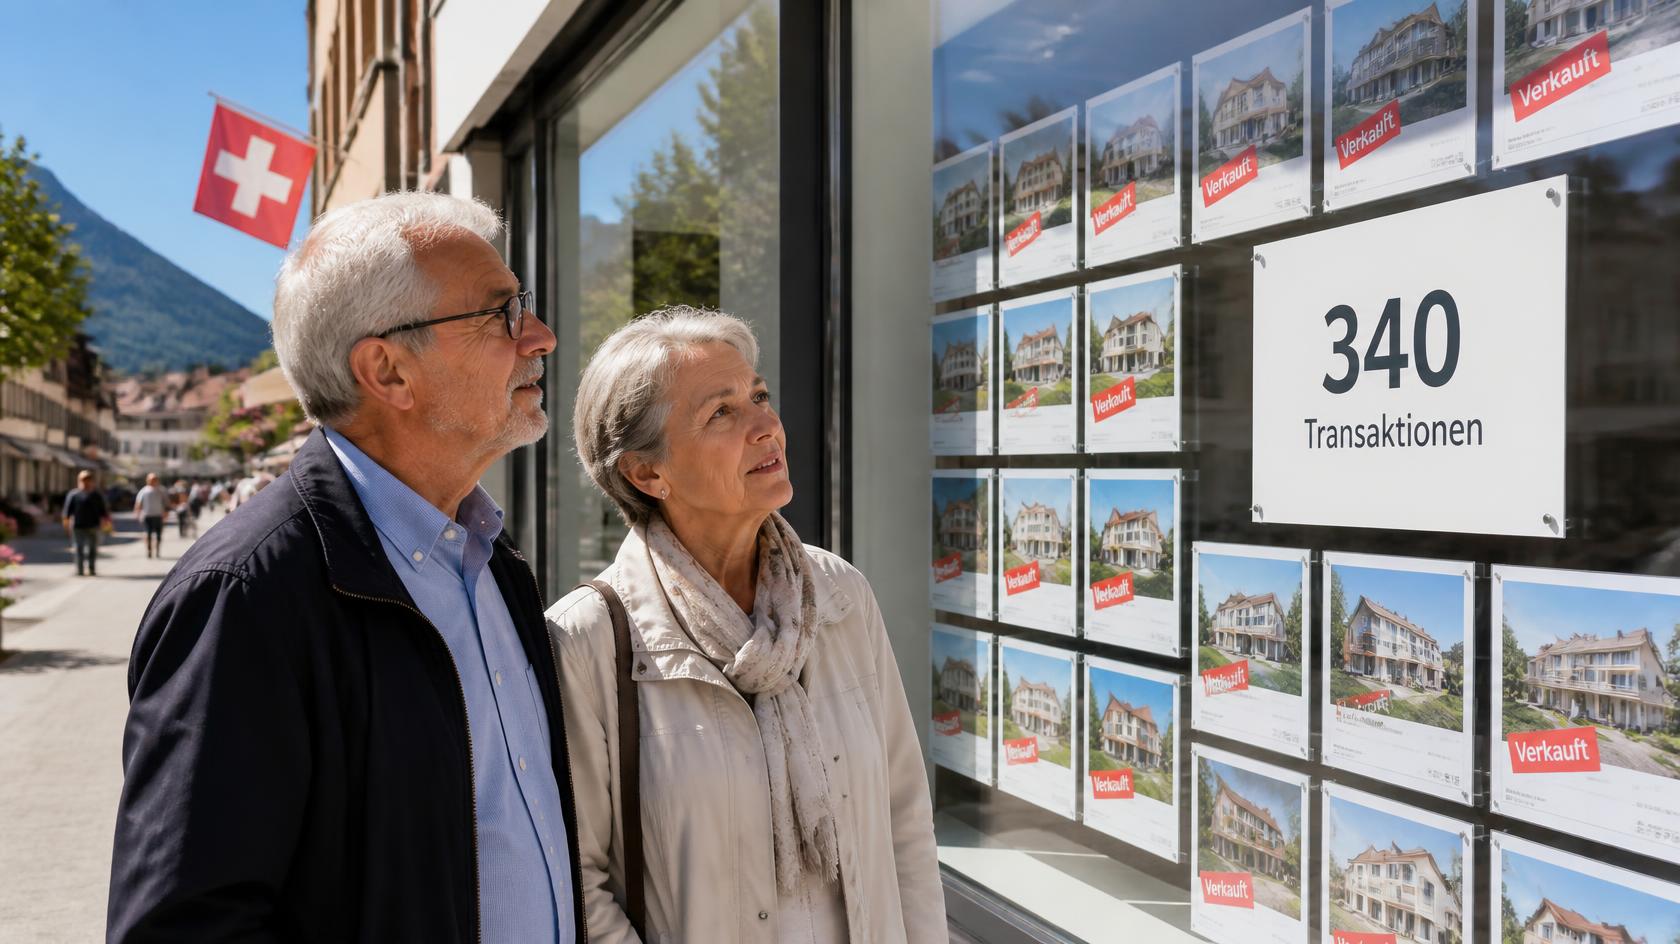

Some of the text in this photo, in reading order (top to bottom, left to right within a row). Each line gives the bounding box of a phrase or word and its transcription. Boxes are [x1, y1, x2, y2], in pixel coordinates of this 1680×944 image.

[1518, 48, 1600, 107] Verkauft
[1205, 156, 1253, 197] Verkauft
[1322, 289, 1460, 394] 340
[1304, 413, 1483, 449] Transaktionen
[1515, 737, 1590, 763] Verkauft
[1093, 774, 1130, 792] Verkauft
[1204, 878, 1249, 899] Verkauft
